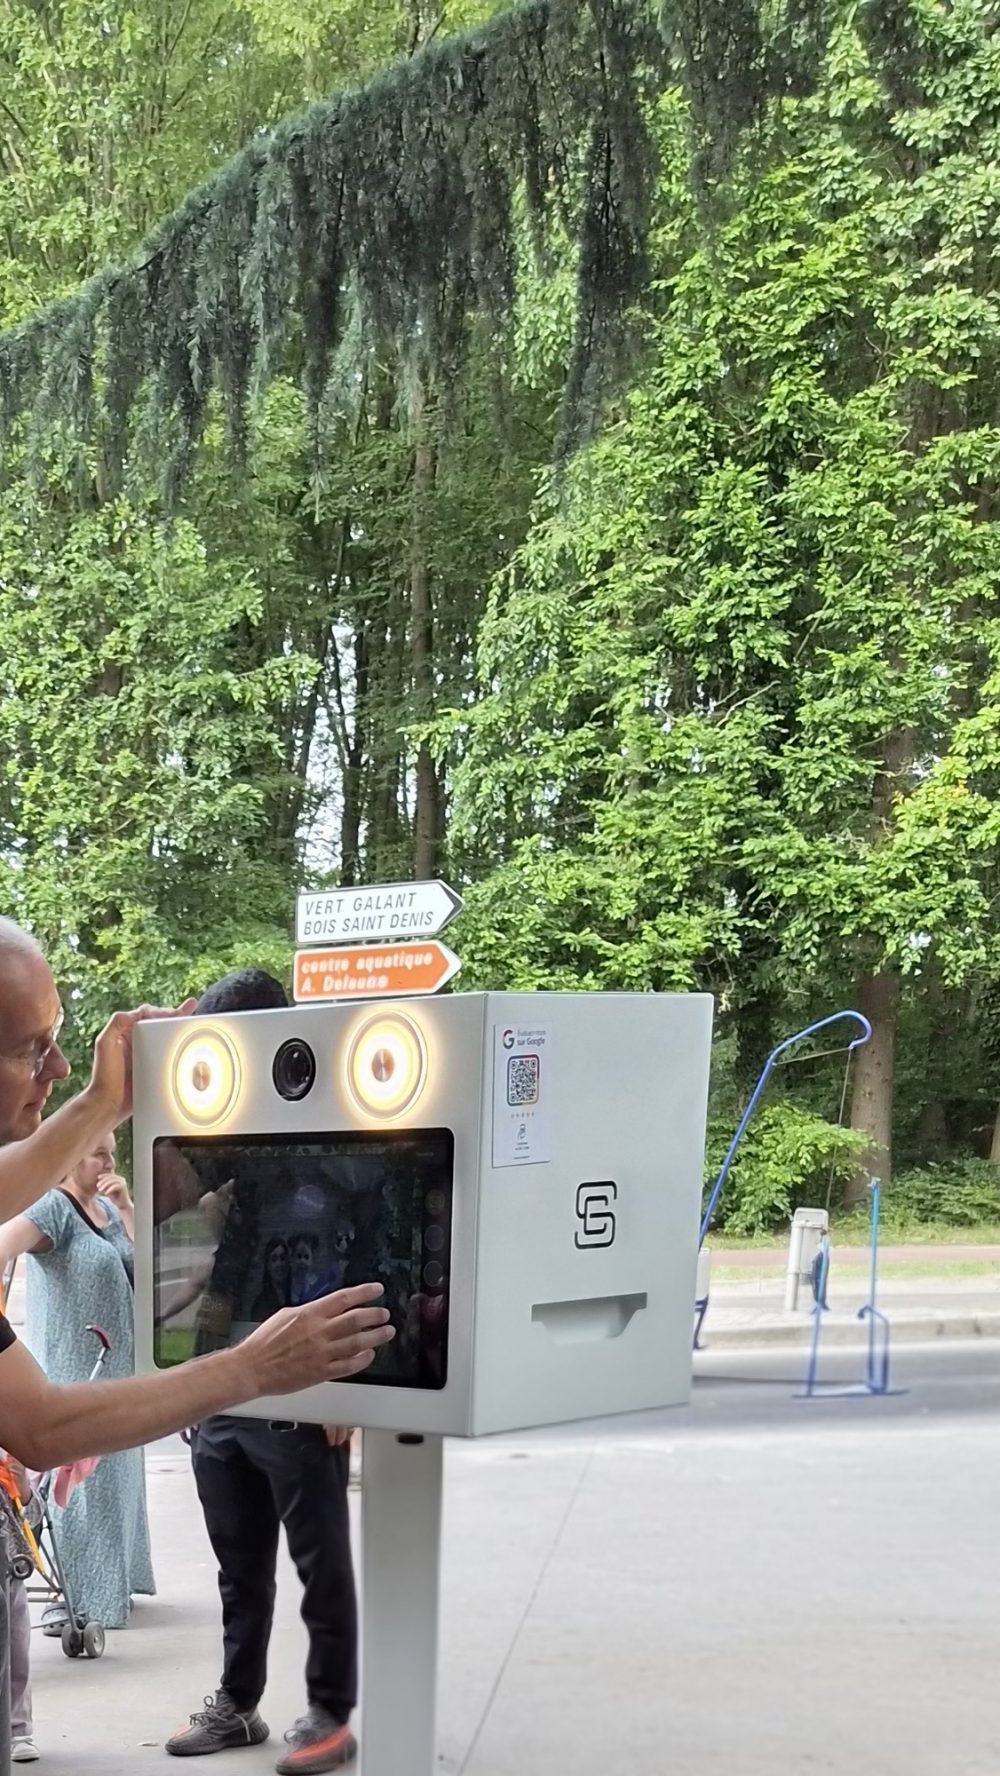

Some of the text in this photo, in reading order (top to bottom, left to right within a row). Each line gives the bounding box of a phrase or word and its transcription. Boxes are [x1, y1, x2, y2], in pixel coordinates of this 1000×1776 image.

[304, 892, 417, 916] VERT GALANT
[303, 911, 434, 935] BOIS SAINT DENIS
[301, 952, 433, 974] centre aquatique
[301, 978, 316, 993] A.
